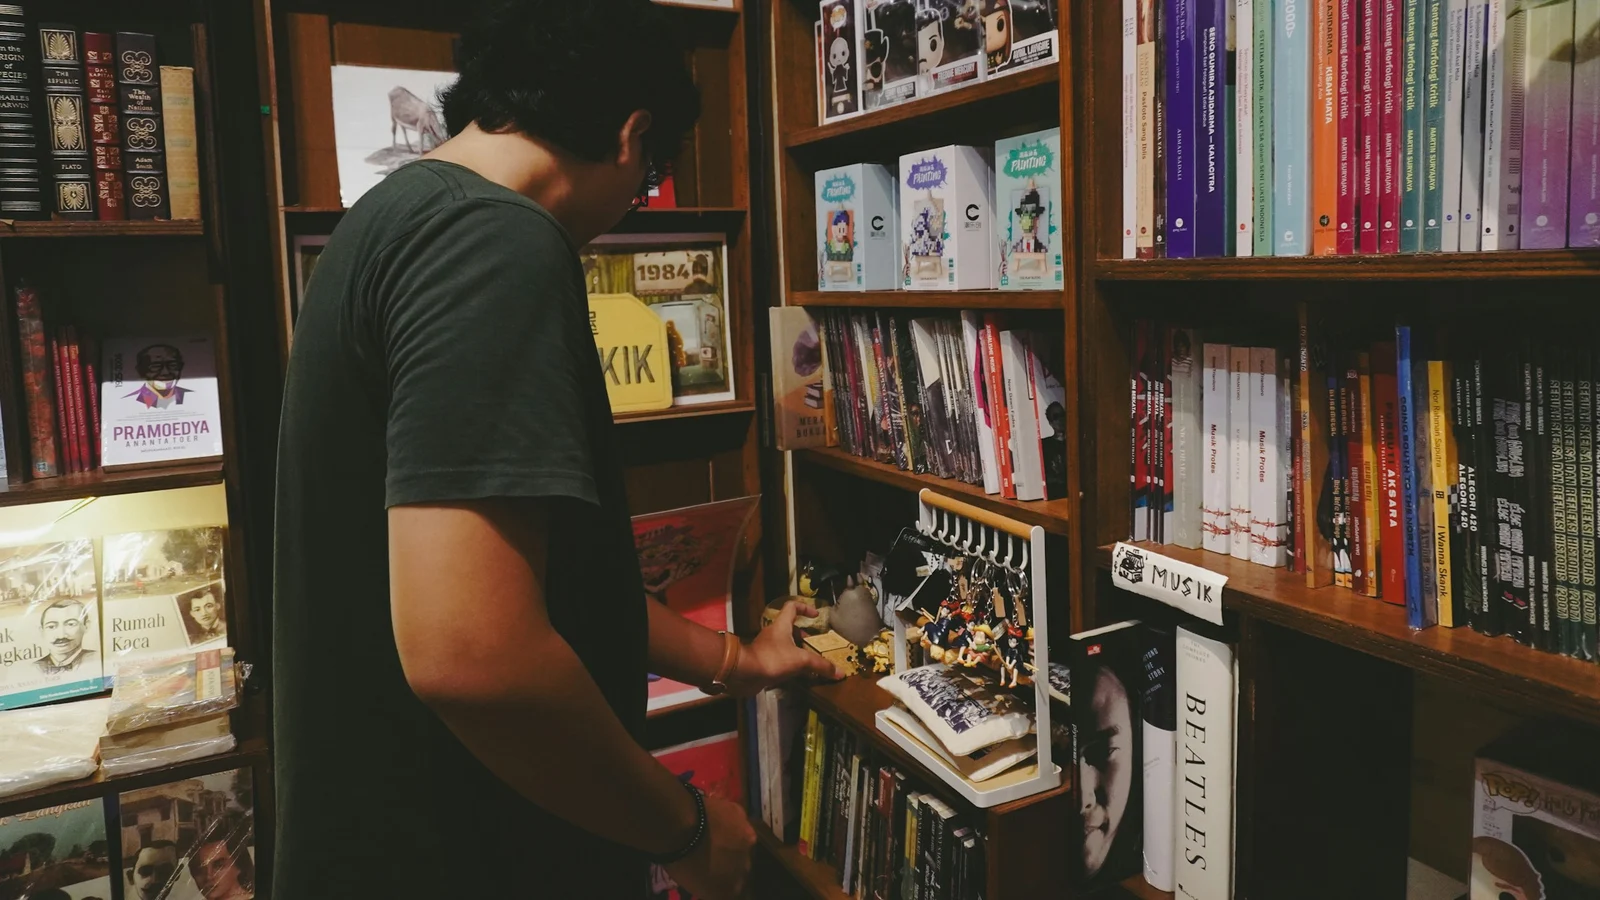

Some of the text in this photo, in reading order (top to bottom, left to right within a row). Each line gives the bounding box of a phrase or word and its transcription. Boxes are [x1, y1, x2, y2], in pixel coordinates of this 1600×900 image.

[1208, 26, 1216, 51] SENO
[1339, 22, 1348, 55] tentang
[1363, 18, 1372, 51] tentang
[1208, 52, 1216, 89] GUMIRA
[1363, 52, 1371, 92] Morfologi
[1384, 13, 1394, 115] tentang Morfologi Kritik
[1406, 7, 1417, 111] tentang Morfologi Kritik
[1429, 2, 1439, 109] tentang Morfologi Kritik
[1325, 66, 1333, 97] KISAH
[1339, 55, 1348, 95] Morfologi
[127, 93, 152, 101] Wealth
[127, 104, 153, 112] Nations
[1141, 91, 1149, 121] Pasfoto
[1208, 89, 1216, 135] AJIDARMA
[1325, 97, 1333, 125] MATA
[1340, 96, 1348, 120] Kritik
[1140, 122, 1148, 142] Sang
[135, 162, 153, 170] Smith
[1011, 155, 1047, 173] PAINTING
[637, 264, 690, 281] 1984
[113, 420, 210, 441] PRAMOEDYA
[125, 434, 199, 448] ANANTA TOER
[1432, 389, 1443, 468] Nor Rahman Saputra
[1350, 466, 1360, 502] Nyanyian
[1400, 396, 1415, 557] GOING SOUTH TO THE NORTH
[1387, 468, 1398, 528] AKSARA
[1458, 463, 1469, 529] ALEGORI 420
[1467, 466, 1478, 532] ALEGORI 420
[1550, 380, 1568, 620] SEBUAH SKETSA DAN REFLEKSI HISTORIS (2007)
[1563, 381, 1581, 623] SEBUAH SKETSA DAN REFLEKSI HISTORIS (2007)
[1579, 380, 1596, 624] SEBUAH SKETSA DAN REFLEKSI HISTORIS (2007)
[1438, 531, 1446, 566] Wanna
[1151, 564, 1213, 603] MUSIK
[1439, 567, 1448, 597] Skank
[112, 613, 166, 634] Rumah
[112, 636, 150, 653] Kaca
[1147, 666, 1166, 682] STORY
[1185, 691, 1207, 872] BEATLES
